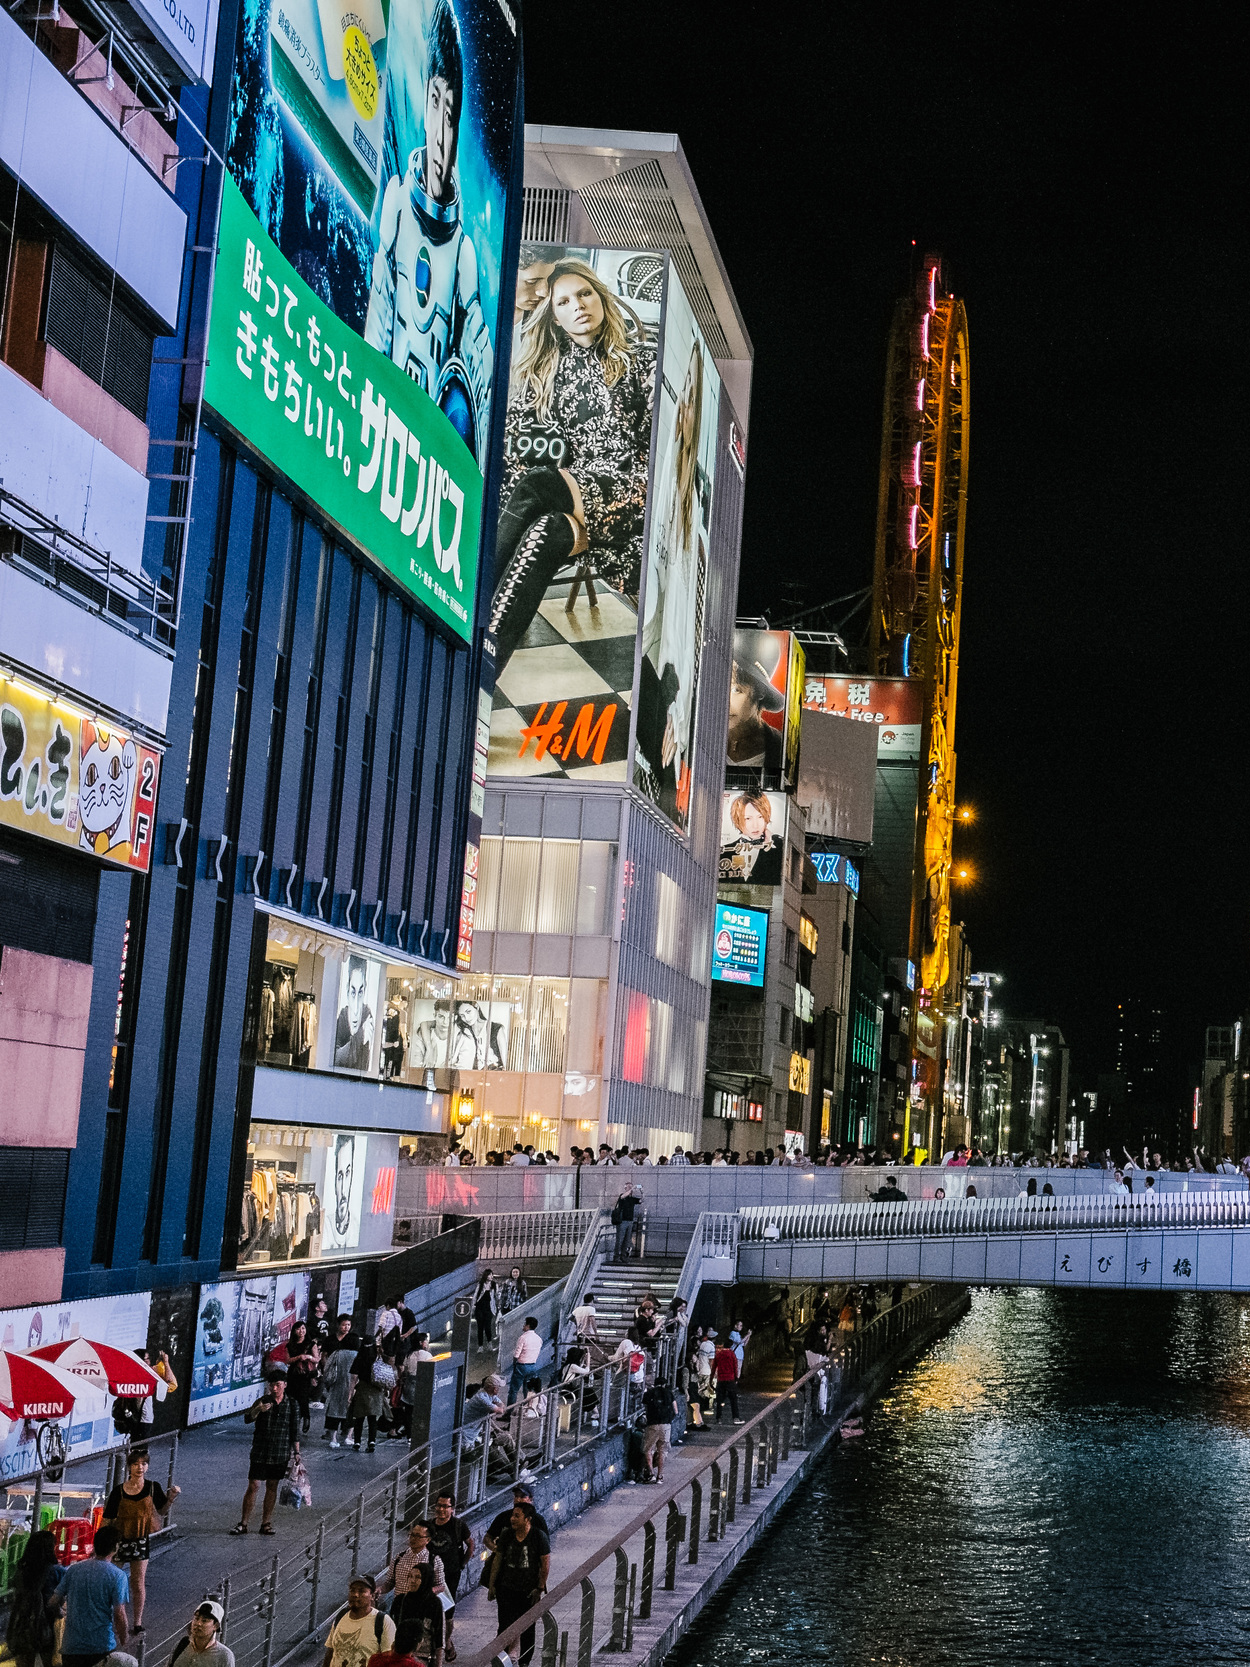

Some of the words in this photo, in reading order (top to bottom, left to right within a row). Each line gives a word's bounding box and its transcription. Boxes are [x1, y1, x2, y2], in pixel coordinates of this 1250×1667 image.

[236, 310, 351, 477] きもちいい。
[357, 378, 465, 588] サロンパス
[804, 681, 870, 706] 免税
[850, 708, 884, 723] Free
[519, 701, 618, 765] H&M
[1060, 1254, 1192, 1278] えびす橋
[116, 1382, 149, 1395] KIRIN
[23, 1402, 64, 1416] KIRIN
